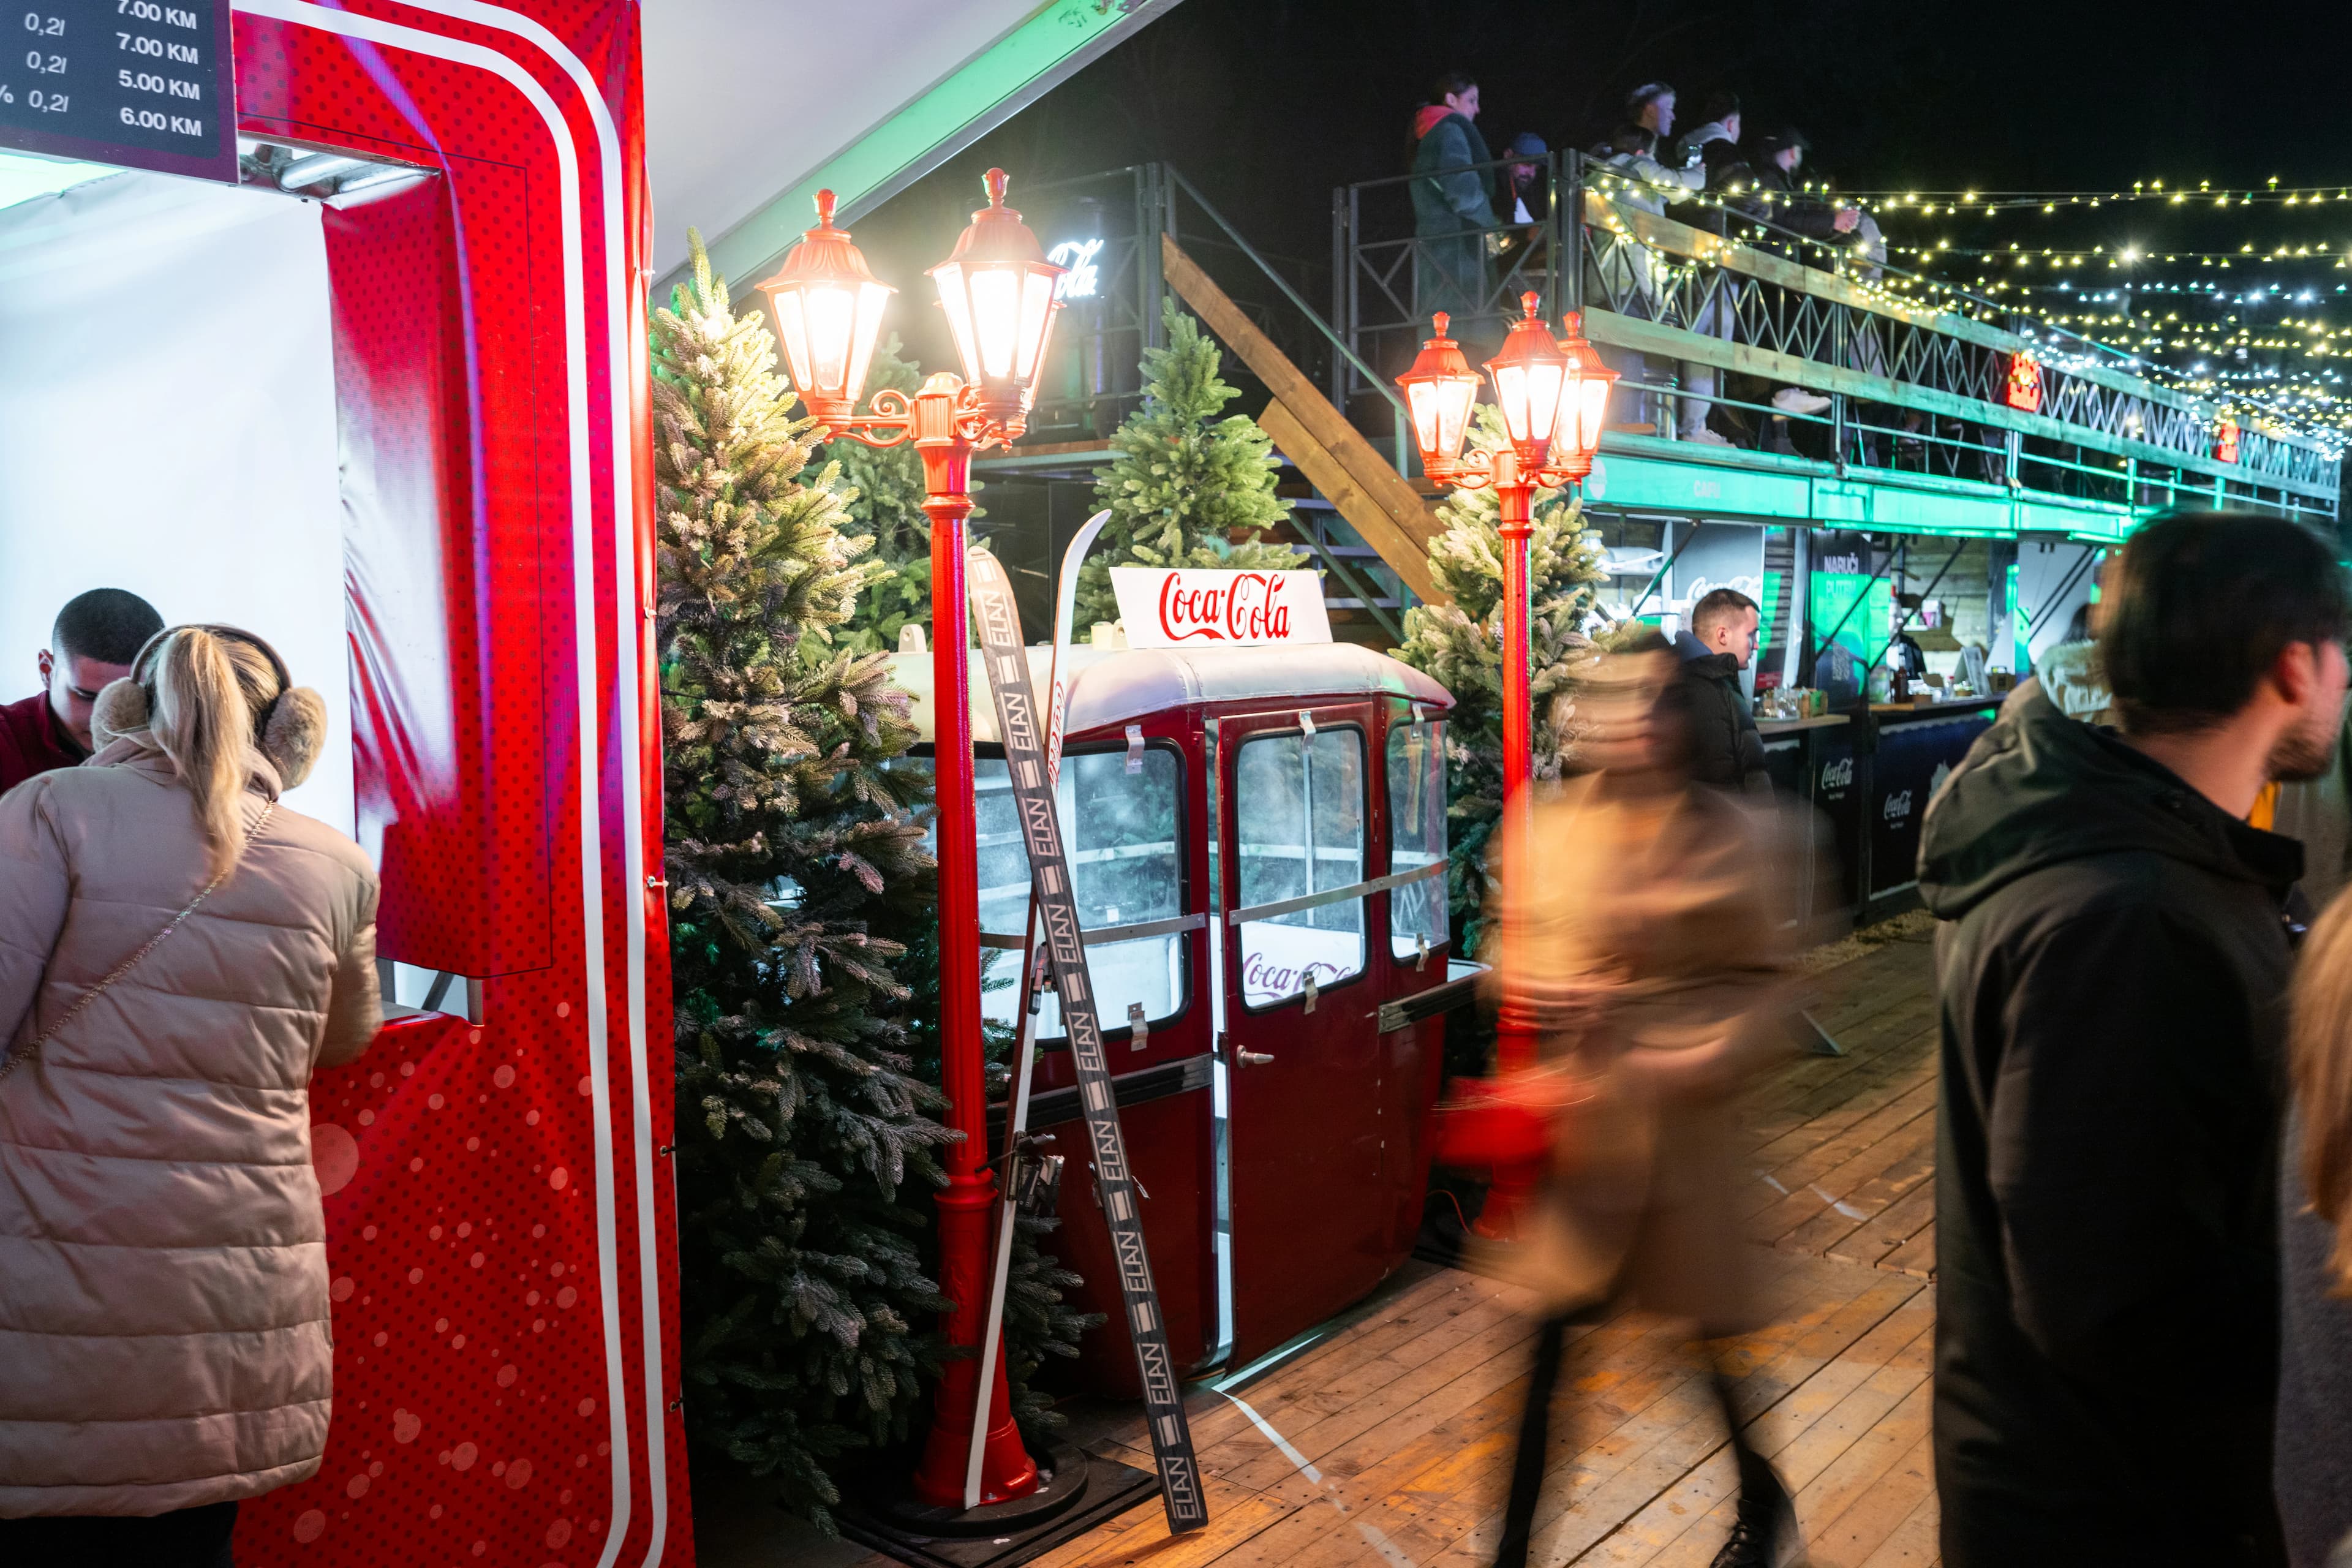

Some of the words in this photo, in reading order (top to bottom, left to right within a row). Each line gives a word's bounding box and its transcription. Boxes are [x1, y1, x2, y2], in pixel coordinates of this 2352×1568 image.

[117, 0, 162, 21] 7.00
[165, 7, 197, 30] KM
[116, 32, 162, 57] 7.00
[167, 43, 198, 64] KM
[118, 69, 165, 94] 5.00
[169, 78, 200, 100] KM
[120, 107, 167, 130] 6.00
[171, 116, 202, 137] KM
[1824, 552, 1859, 574] NARUČI
[986, 590, 1011, 647] ELAN
[1159, 572, 1291, 641] Coca-Cola
[1005, 693, 1033, 751] ELAN
[1027, 798, 1055, 856] ELAN
[1049, 904, 1078, 963] ELAN
[1072, 1012, 1100, 1071] ELAN
[1094, 1121, 1124, 1180] ELAN
[1117, 1231, 1147, 1292] ELAN
[1142, 1343, 1172, 1404] ELAN
[1166, 1457, 1196, 1518] ELAN
